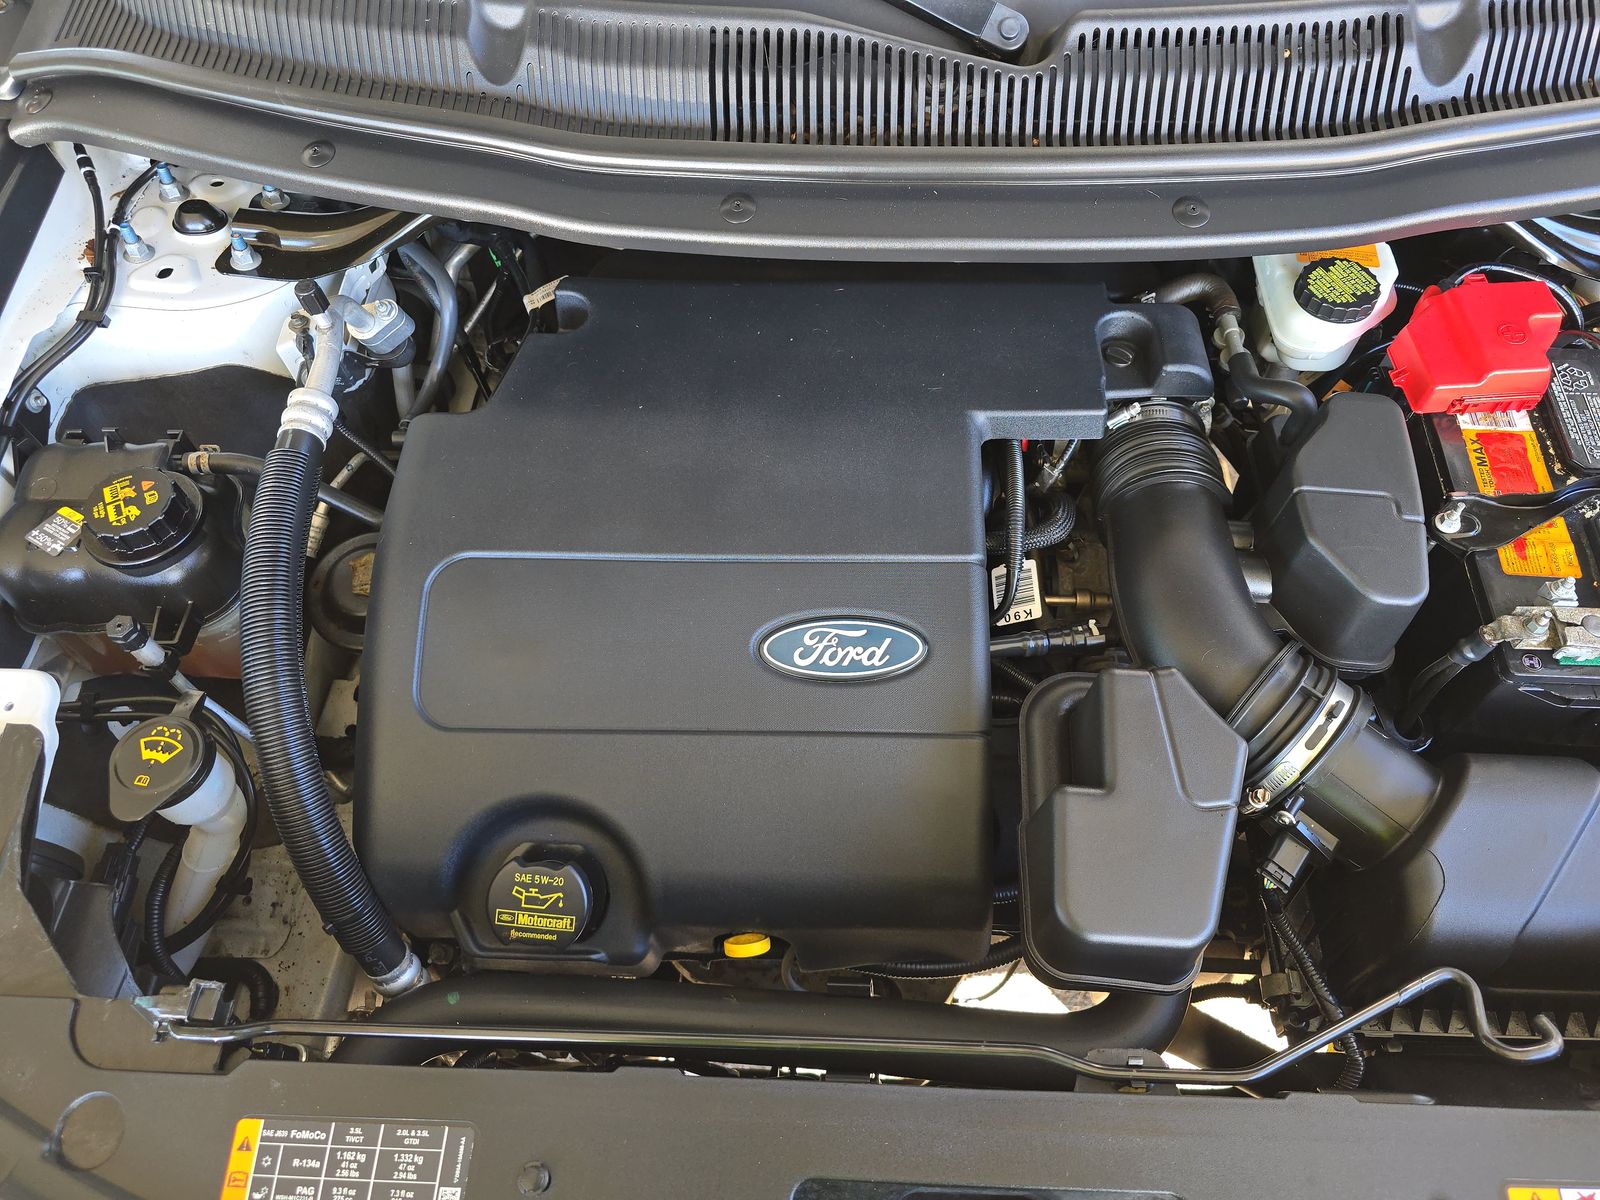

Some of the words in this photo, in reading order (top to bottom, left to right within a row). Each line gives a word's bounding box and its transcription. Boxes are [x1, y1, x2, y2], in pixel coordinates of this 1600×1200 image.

[1470, 438, 1488, 466] MAX
[1478, 468, 1488, 488] TESTED
[793, 627, 892, 666] Ford
[514, 872, 532, 883] SAE
[534, 875, 564, 886] 5W-20
[518, 913, 572, 930] Motorcraft
[510, 928, 557, 940] Recommended
[290, 1130, 326, 1140] FoMoCo
[292, 1158, 320, 1168] R-134a
[356, 1152, 366, 1163] kg
[394, 1153, 413, 1162] 1.332
[414, 1154, 424, 1164] kg
[296, 1186, 315, 1195] PAG
